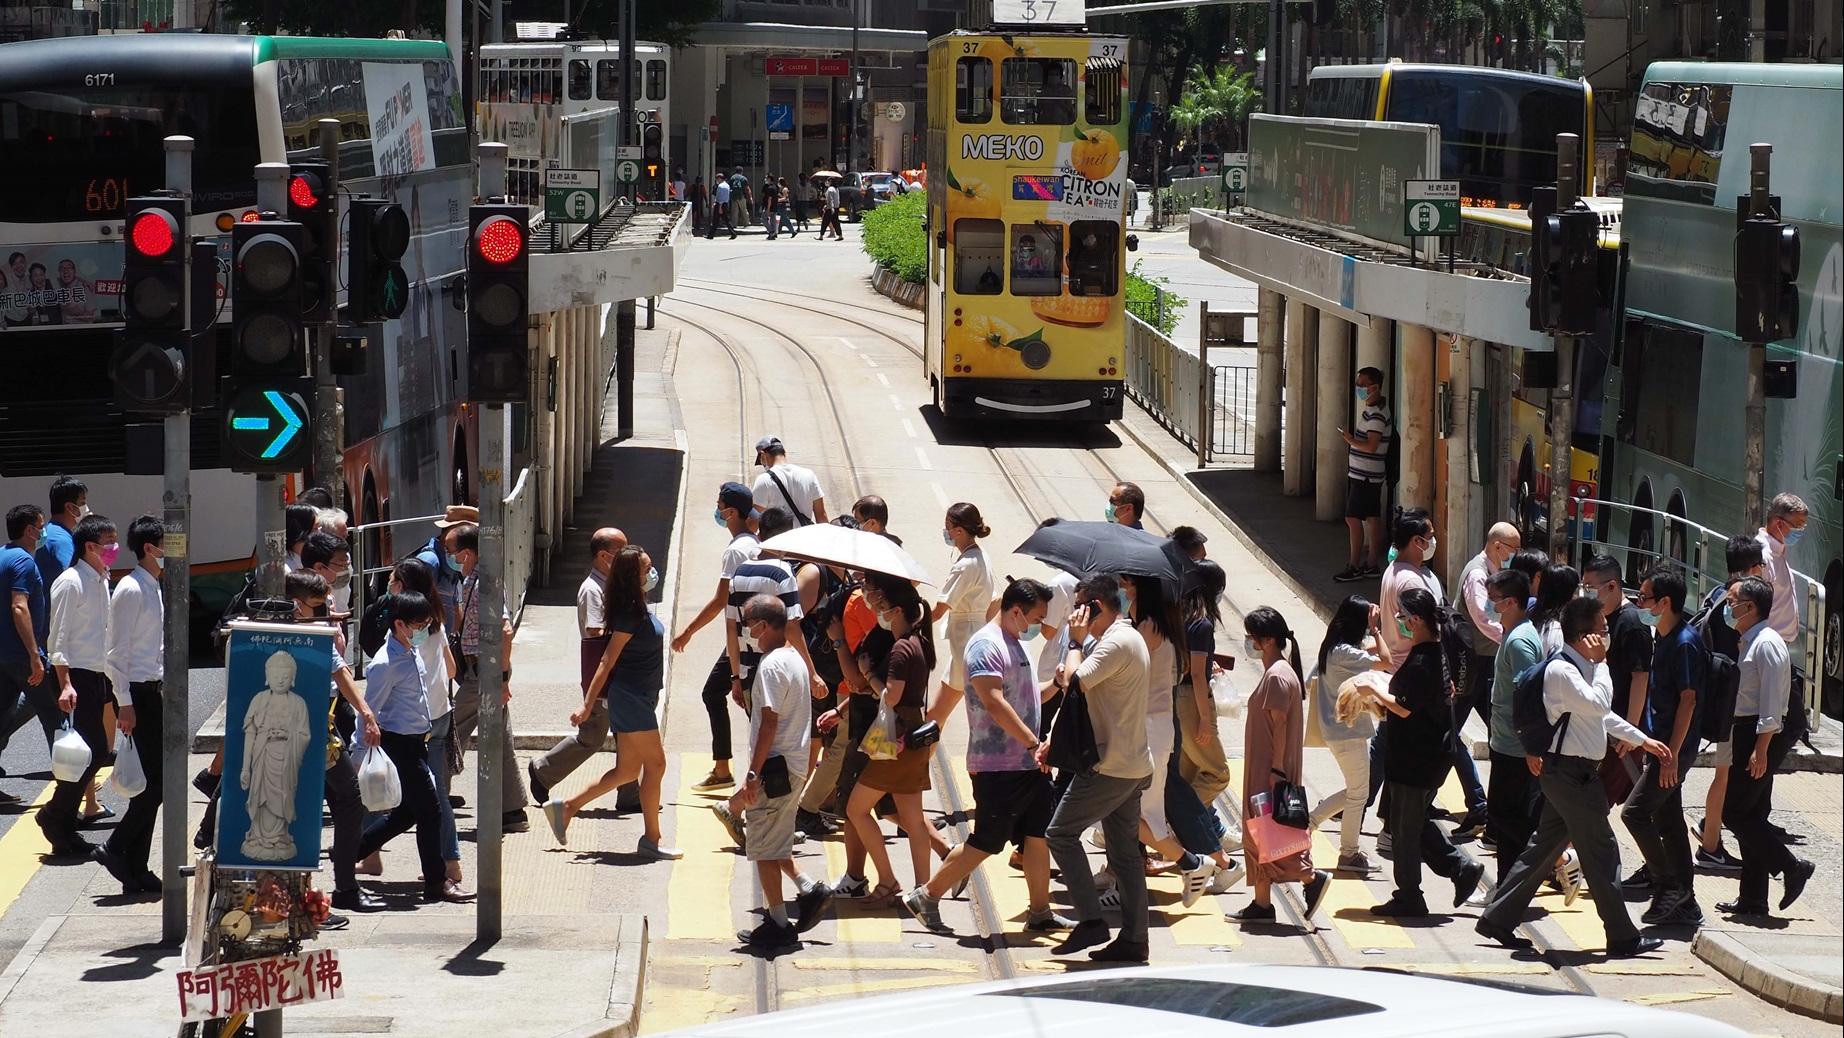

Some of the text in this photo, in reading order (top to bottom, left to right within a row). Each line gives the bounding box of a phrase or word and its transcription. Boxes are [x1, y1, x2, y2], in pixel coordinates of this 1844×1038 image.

[1021, 0, 1057, 21] 37
[962, 43, 978, 54] 37
[1102, 45, 1117, 57] 37
[85, 73, 114, 87] 6171
[962, 134, 1044, 161] MEKO
[1060, 167, 1086, 177] KOREAN
[86, 176, 128, 212] 601
[1063, 174, 1121, 199] CITRON
[1103, 387, 1115, 398] 37
[176, 949, 342, 1018] 阿彌陀佛
